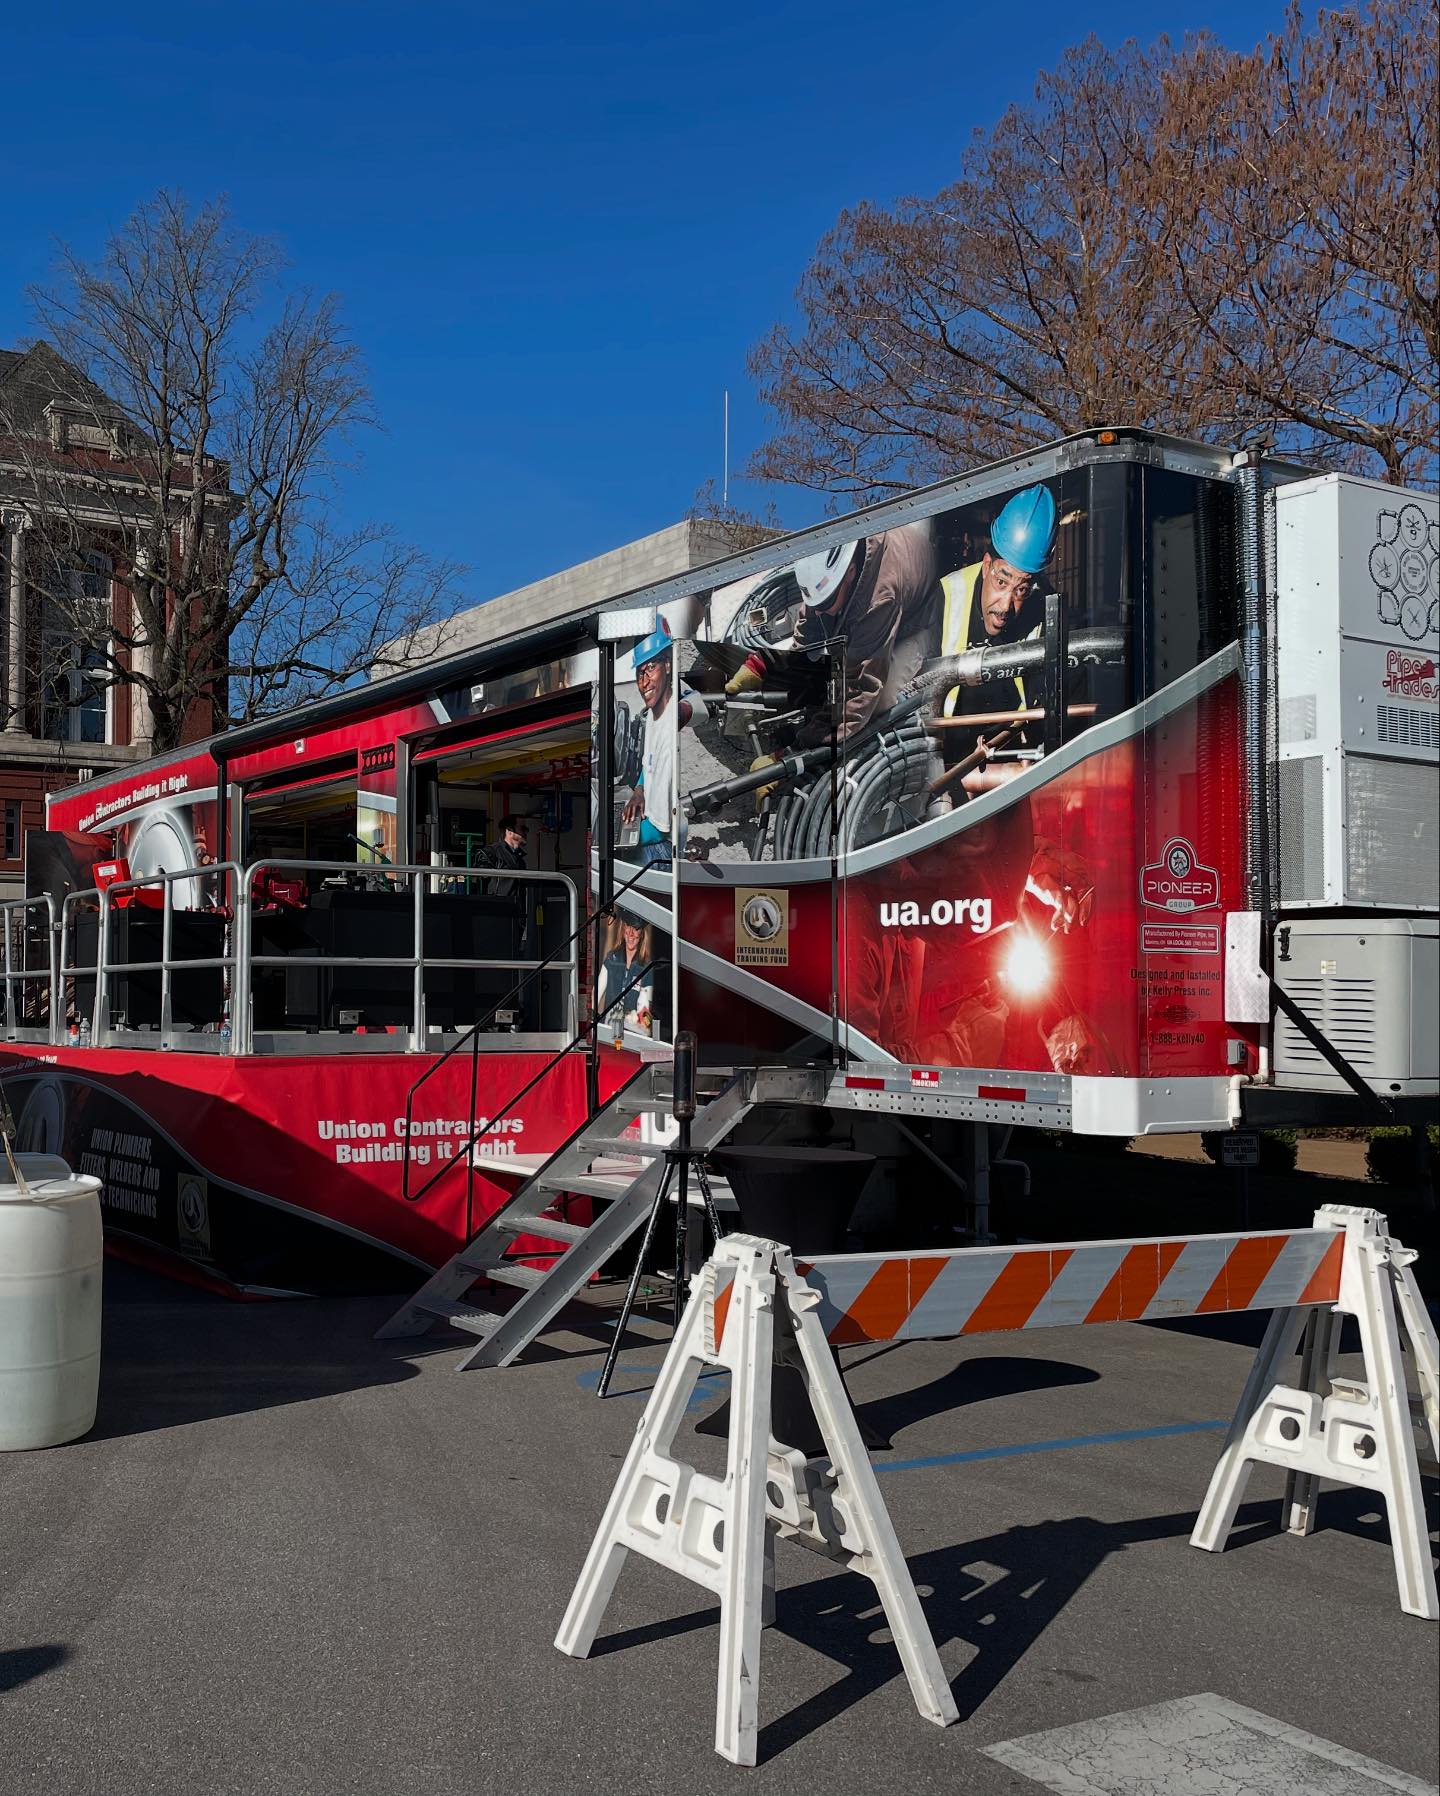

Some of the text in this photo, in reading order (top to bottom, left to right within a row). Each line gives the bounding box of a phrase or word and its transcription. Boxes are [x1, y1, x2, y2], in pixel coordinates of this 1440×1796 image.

[1386, 650, 1422, 678] Pipe
[79, 813, 95, 832] Union
[132, 784, 160, 803] Building
[161, 780, 167, 793] it
[168, 774, 188, 792] Right
[1147, 881, 1213, 895] PIONEER
[1168, 901, 1192, 909] GROUP
[880, 898, 992, 934] ua.org
[736, 947, 787, 955] INTERNATIONAL
[737, 955, 787, 964] TRAINING FUND
[1131, 969, 1221, 981] Designed and Installed
[1153, 985, 1173, 997] Kelly
[1174, 986, 1196, 996] Press
[911, 1079, 939, 1088] SMOKING
[920, 1071, 930, 1079] NO
[318, 1117, 525, 1140] Union Contractors
[91, 1128, 152, 1164] UNION PLUMBERS,
[335, 1143, 431, 1166] Building
[436, 1140, 453, 1160] it
[109, 1157, 142, 1187] WELDERS
[142, 1165, 160, 1191] AND
[108, 1185, 157, 1218] TECHNICIANS
